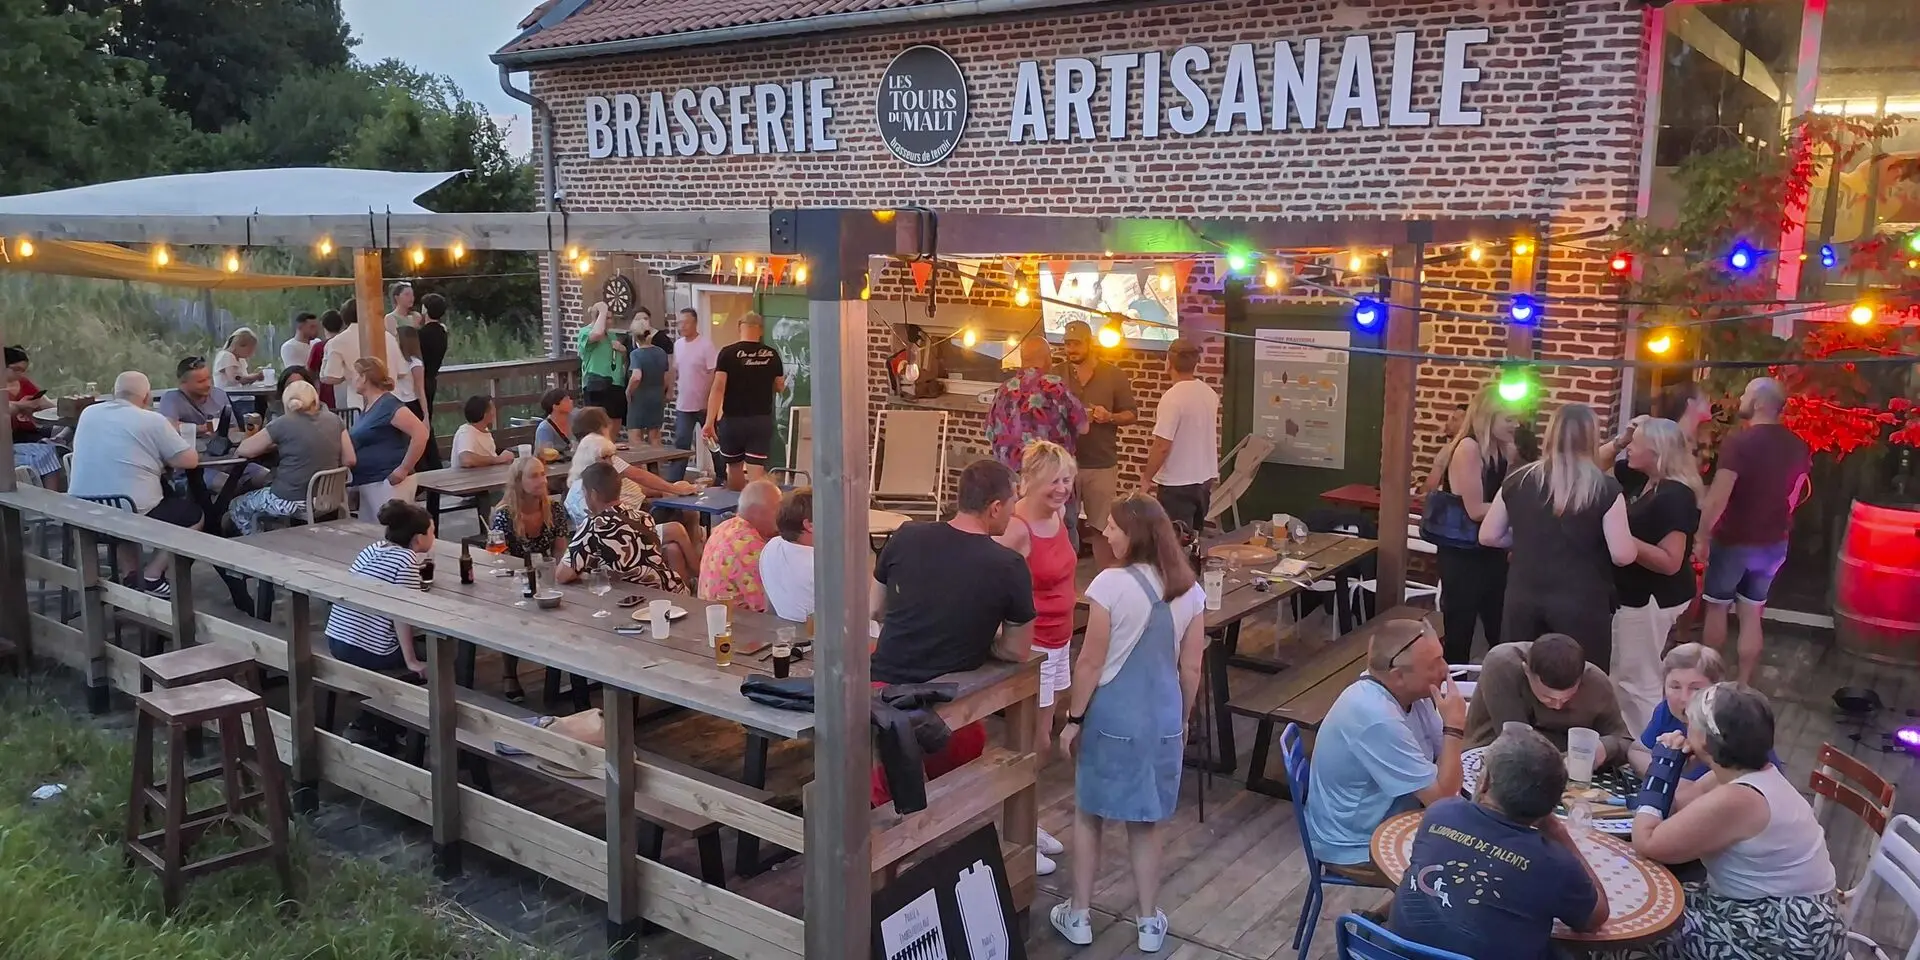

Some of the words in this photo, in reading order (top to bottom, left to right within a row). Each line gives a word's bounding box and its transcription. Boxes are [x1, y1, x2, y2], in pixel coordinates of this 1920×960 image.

[889, 75, 912, 88] LES
[1008, 28, 1490, 143] ARTISANALE
[889, 89, 957, 110] TOURS
[585, 77, 838, 160] BRASSERIE
[889, 112, 903, 122] DU
[903, 111, 957, 131] MALT
[889, 136, 921, 162] brasseurs
[921, 150, 931, 162] de
[930, 138, 952, 158] terroir
[1474, 839, 1491, 852] DE
[1488, 845, 1531, 871] TALENTS
